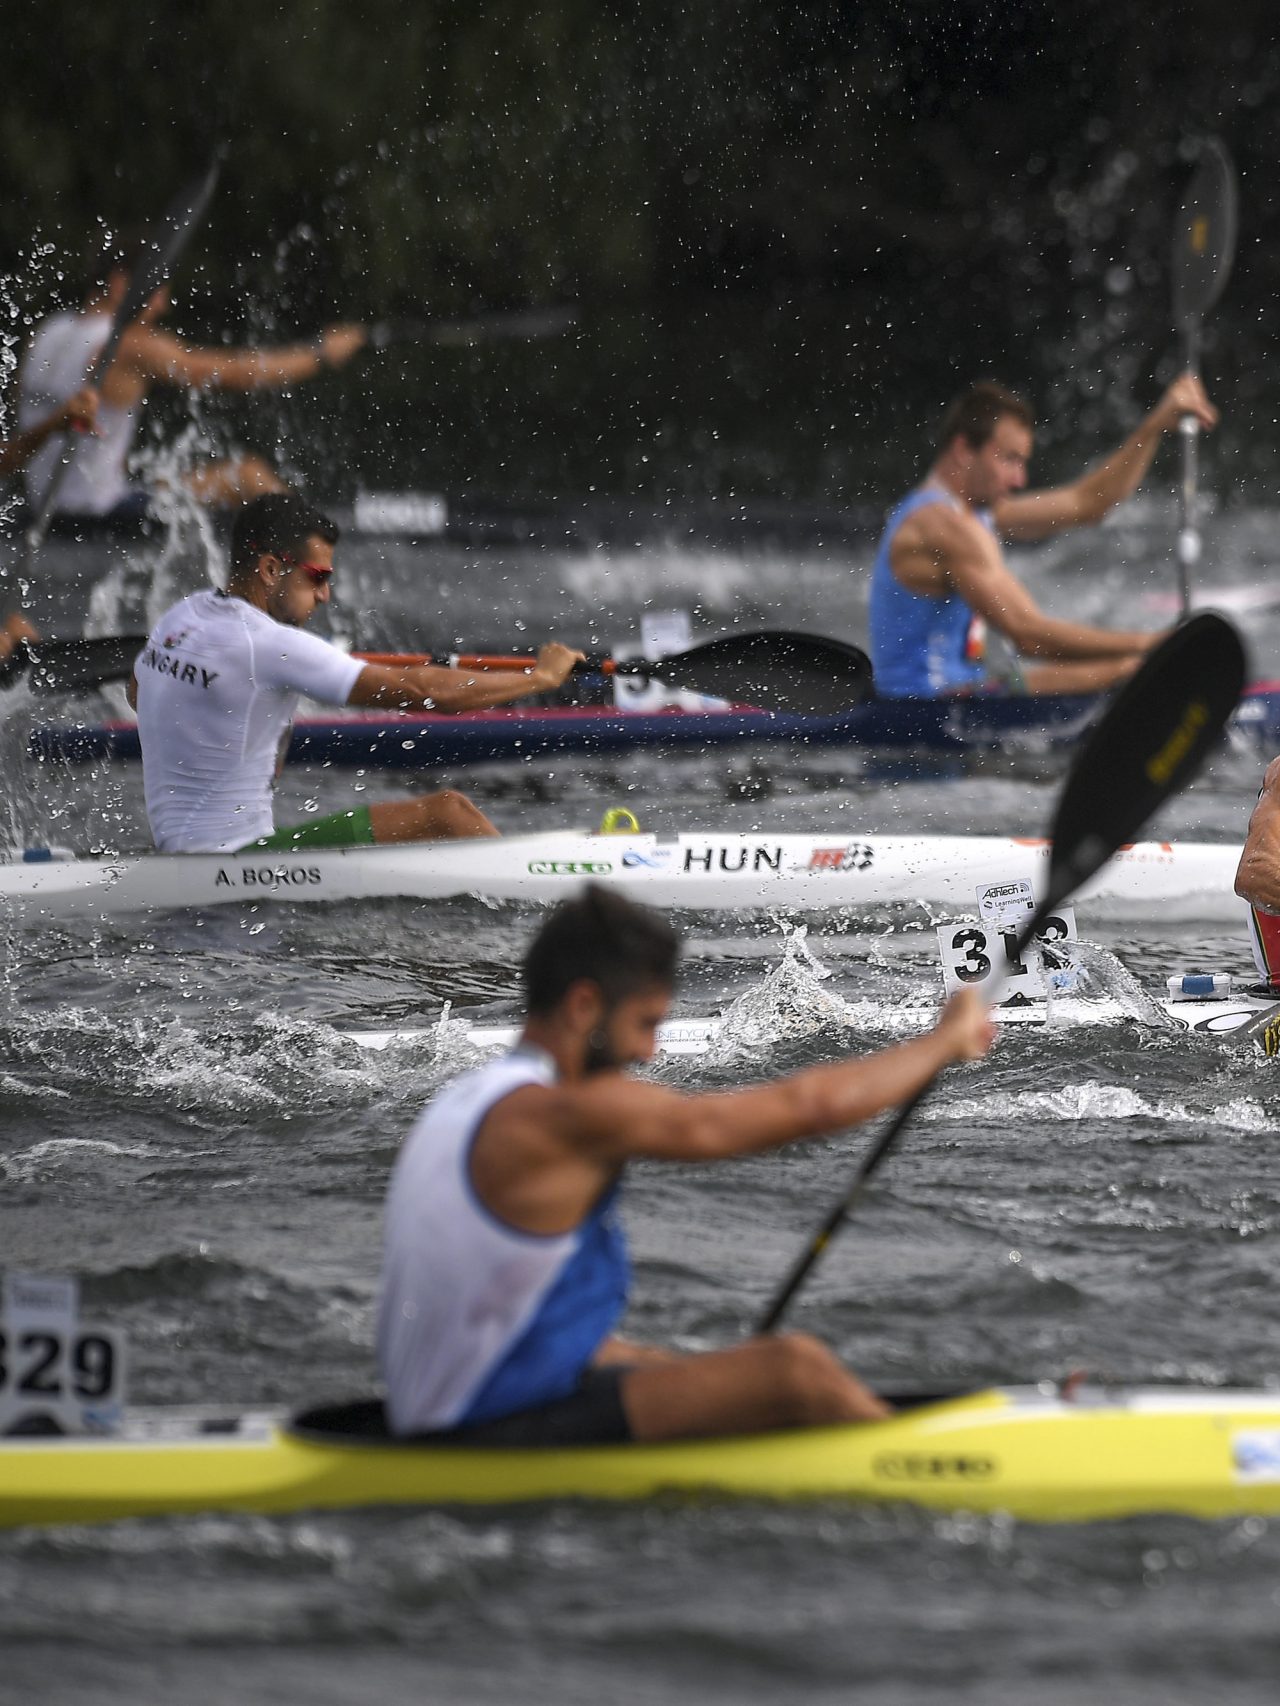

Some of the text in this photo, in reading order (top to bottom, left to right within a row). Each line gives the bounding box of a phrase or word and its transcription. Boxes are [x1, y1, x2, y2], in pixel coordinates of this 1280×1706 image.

[142, 649, 219, 689] NGARY
[684, 847, 783, 872] HUN
[215, 867, 322, 887] A. BOROS
